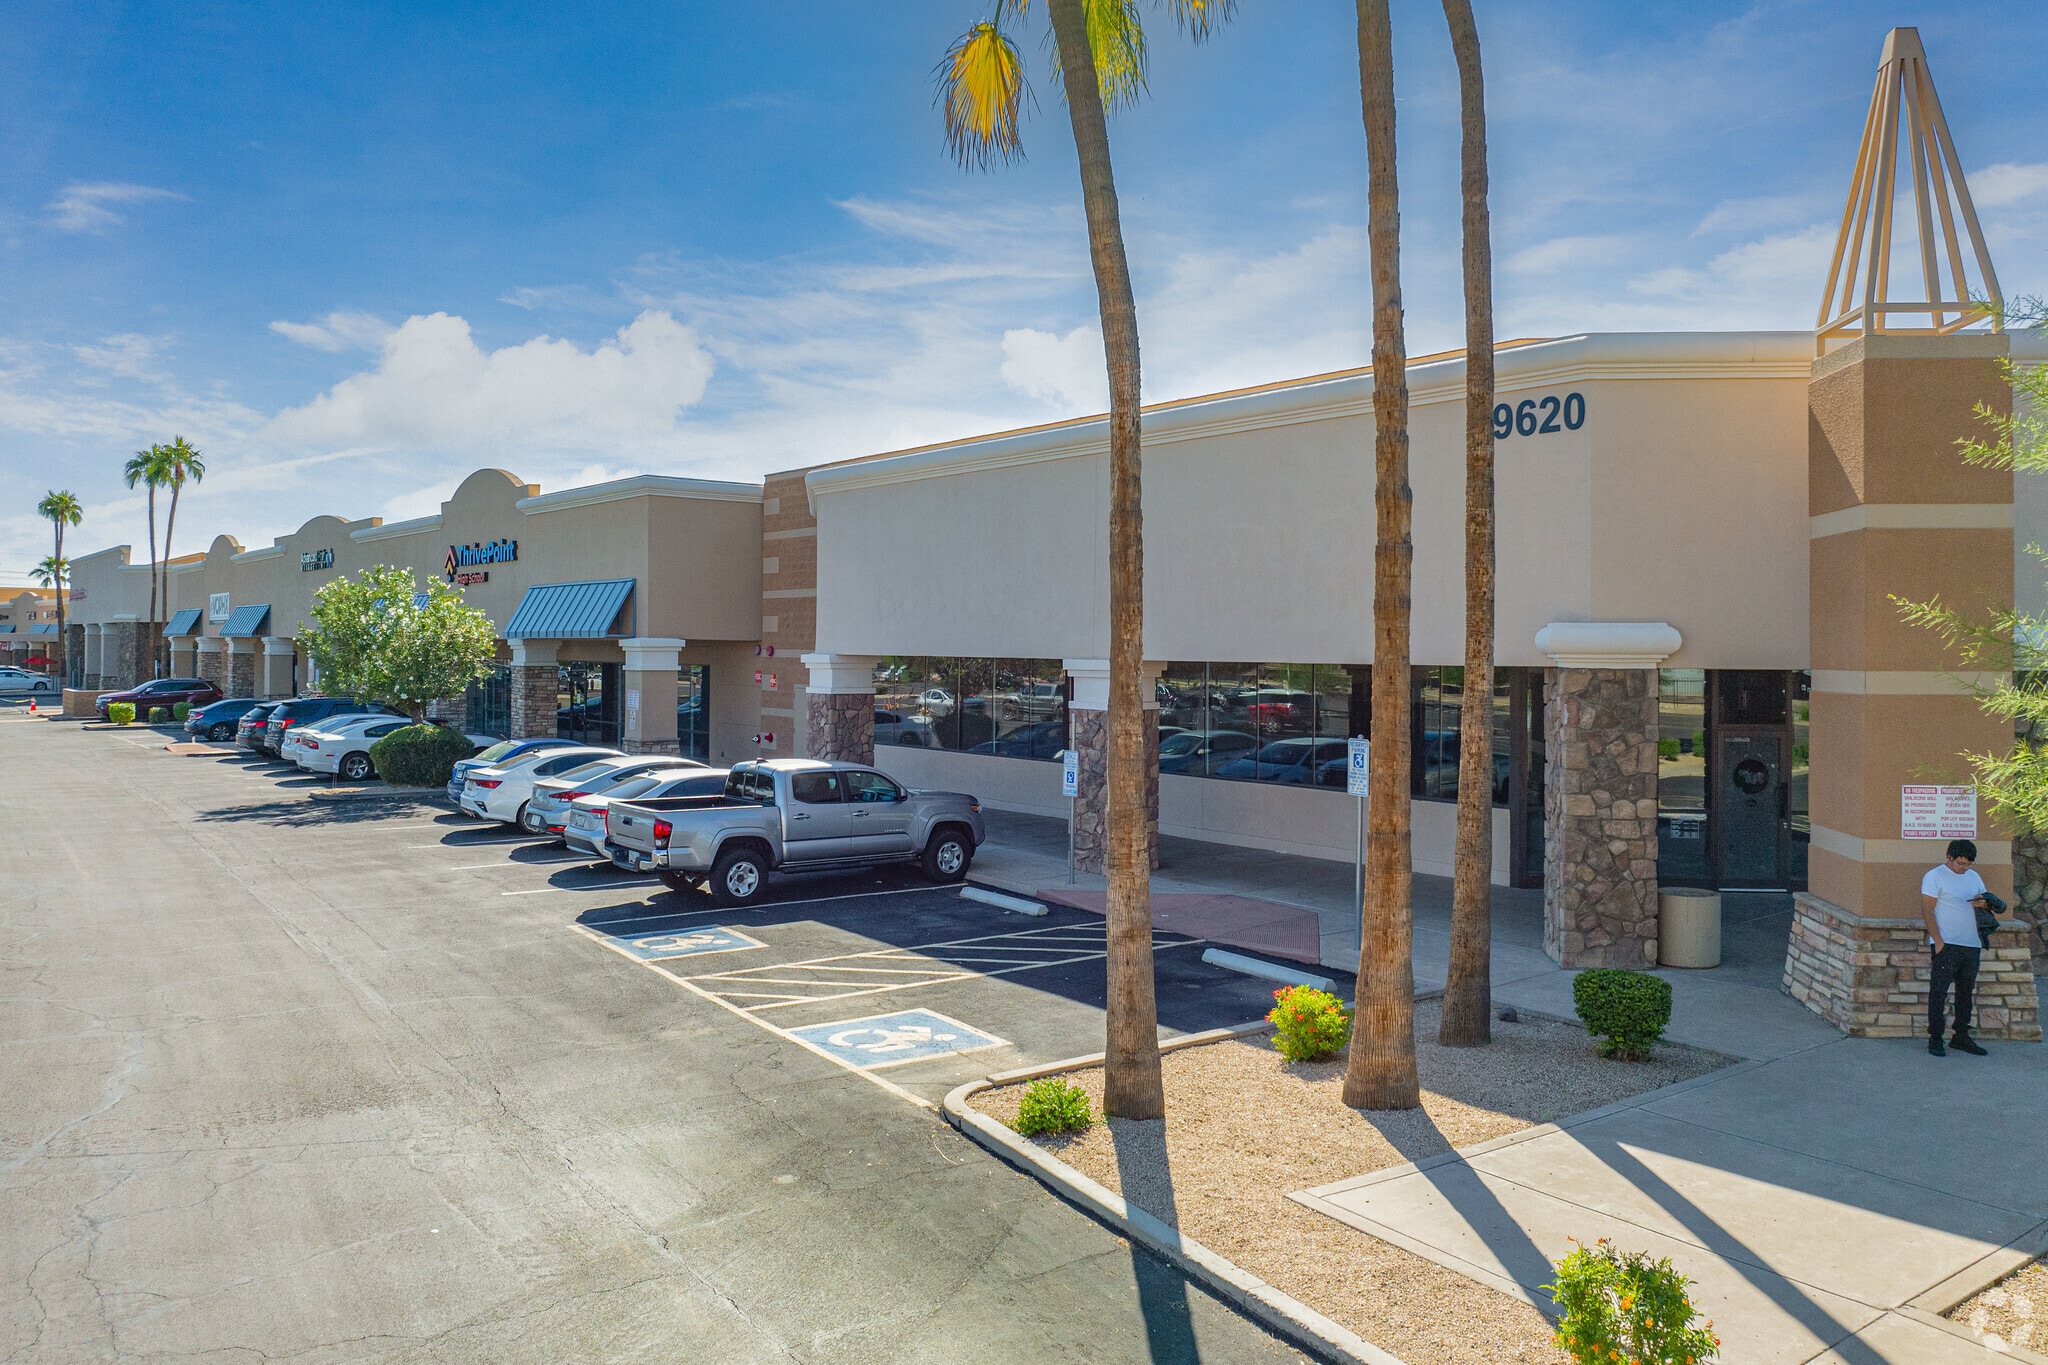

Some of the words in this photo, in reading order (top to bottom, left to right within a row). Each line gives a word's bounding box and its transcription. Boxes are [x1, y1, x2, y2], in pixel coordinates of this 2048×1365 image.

[1493, 393, 1585, 439] 9620
[457, 538, 516, 566] ThrivePoint
[458, 573, 468, 585] High
[468, 572, 487, 583] School
